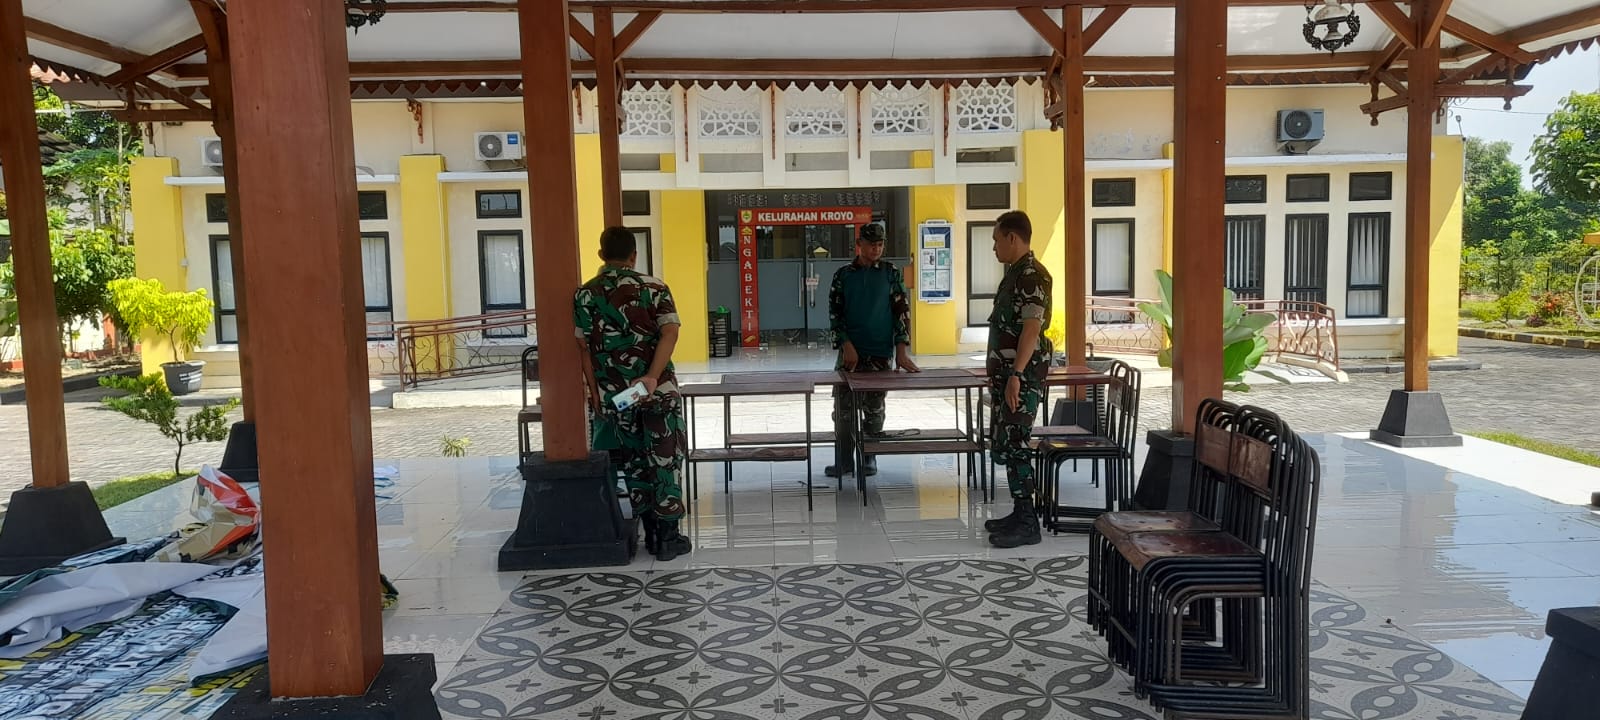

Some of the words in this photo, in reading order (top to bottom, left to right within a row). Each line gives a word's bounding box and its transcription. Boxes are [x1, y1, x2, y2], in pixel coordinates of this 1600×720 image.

[758, 212, 818, 222] KELURAHAN
[820, 211, 854, 221] KROYO
[743, 235, 754, 332] NGABEKTI
